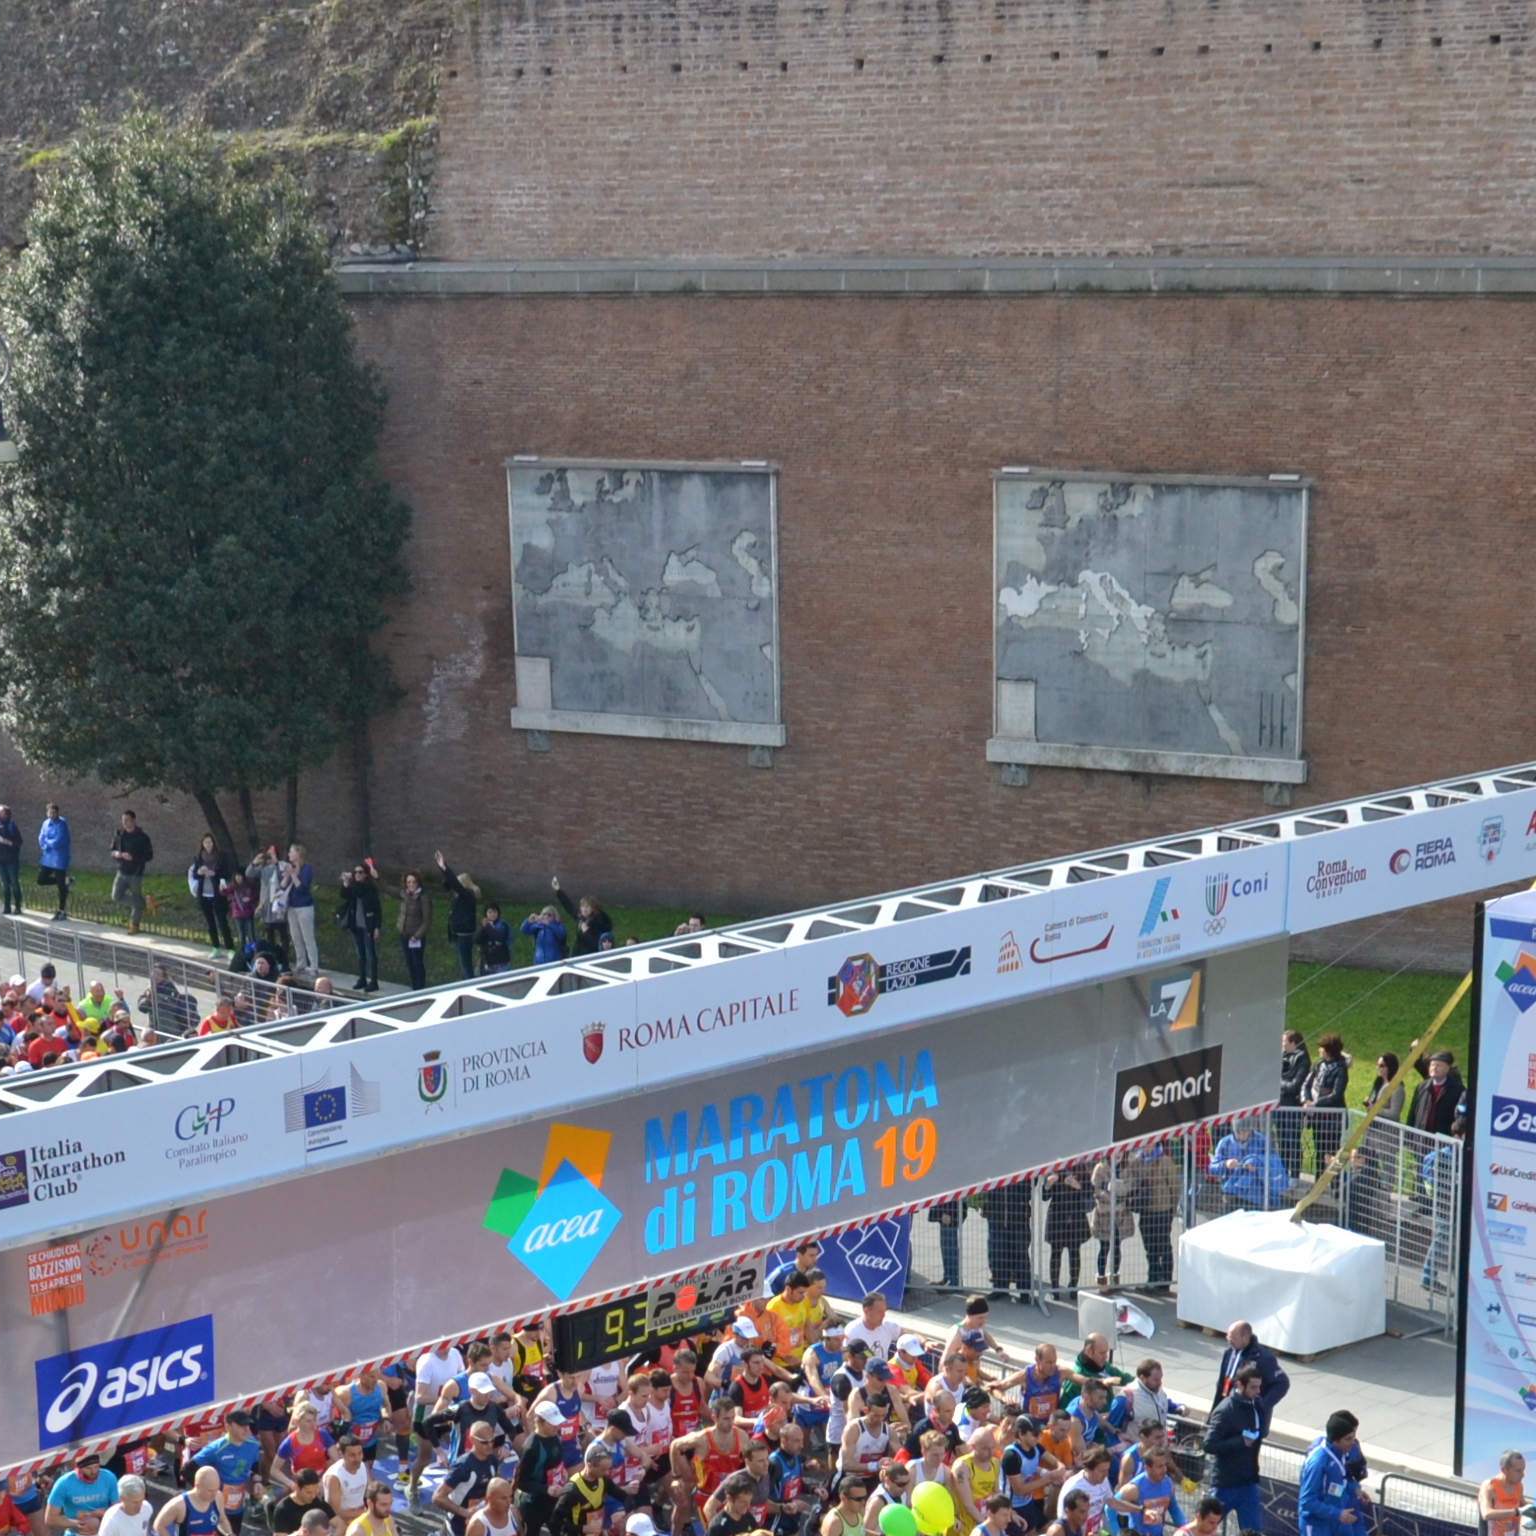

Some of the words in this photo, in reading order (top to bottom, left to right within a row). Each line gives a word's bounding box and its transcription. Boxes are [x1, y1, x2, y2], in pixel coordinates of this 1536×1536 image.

[1416, 838, 1453, 857] FIERA
[1317, 859, 1348, 877] Roma
[1415, 852, 1456, 872] ROMA
[1206, 872, 1229, 884] Italia
[1232, 872, 1268, 897] Coni
[1307, 866, 1366, 893] Convention
[886, 956, 930, 976] REGIONE
[886, 975, 916, 992] LAZIO
[617, 1013, 691, 1053] ROMA
[695, 988, 799, 1031] CAPITALE
[461, 1040, 548, 1073] PROVINCIA
[462, 1075, 480, 1094] DI
[484, 1065, 532, 1088] ROMA
[1151, 1068, 1212, 1108] smart
[644, 1049, 939, 1184] MARATONA
[30, 1139, 83, 1164] Italia
[165, 1142, 211, 1161] Comitato
[212, 1133, 249, 1150] Italiano
[178, 1147, 237, 1170] Paralimpico
[31, 1148, 126, 1183] Marathon
[1500, 1166, 1536, 1181] UniCredit
[33, 1178, 79, 1202] Club
[644, 1180, 695, 1255] di
[712, 1137, 866, 1238] ROMA
[874, 1117, 938, 1188] 19
[120, 1209, 208, 1251] unar
[523, 1208, 604, 1254] acea
[28, 1253, 37, 1264] SE
[38, 1247, 64, 1262] CHIUDI
[65, 1243, 80, 1256] COL
[854, 1252, 892, 1271] acea
[29, 1255, 82, 1281] RAZZISMO
[674, 1271, 711, 1289] OFFICIAL
[714, 1264, 742, 1278] TIMING
[30, 1283, 39, 1294] TI
[40, 1281, 47, 1292] SI
[47, 1275, 68, 1290] APRE
[70, 1272, 82, 1284] UN
[653, 1268, 757, 1318] POLAR
[30, 1284, 85, 1317] MONDO
[654, 1310, 689, 1327] LISTENS
[691, 1307, 703, 1316] TO
[705, 1301, 728, 1313] YOUR
[730, 1293, 753, 1305] BODY
[98, 1344, 203, 1408] asics
